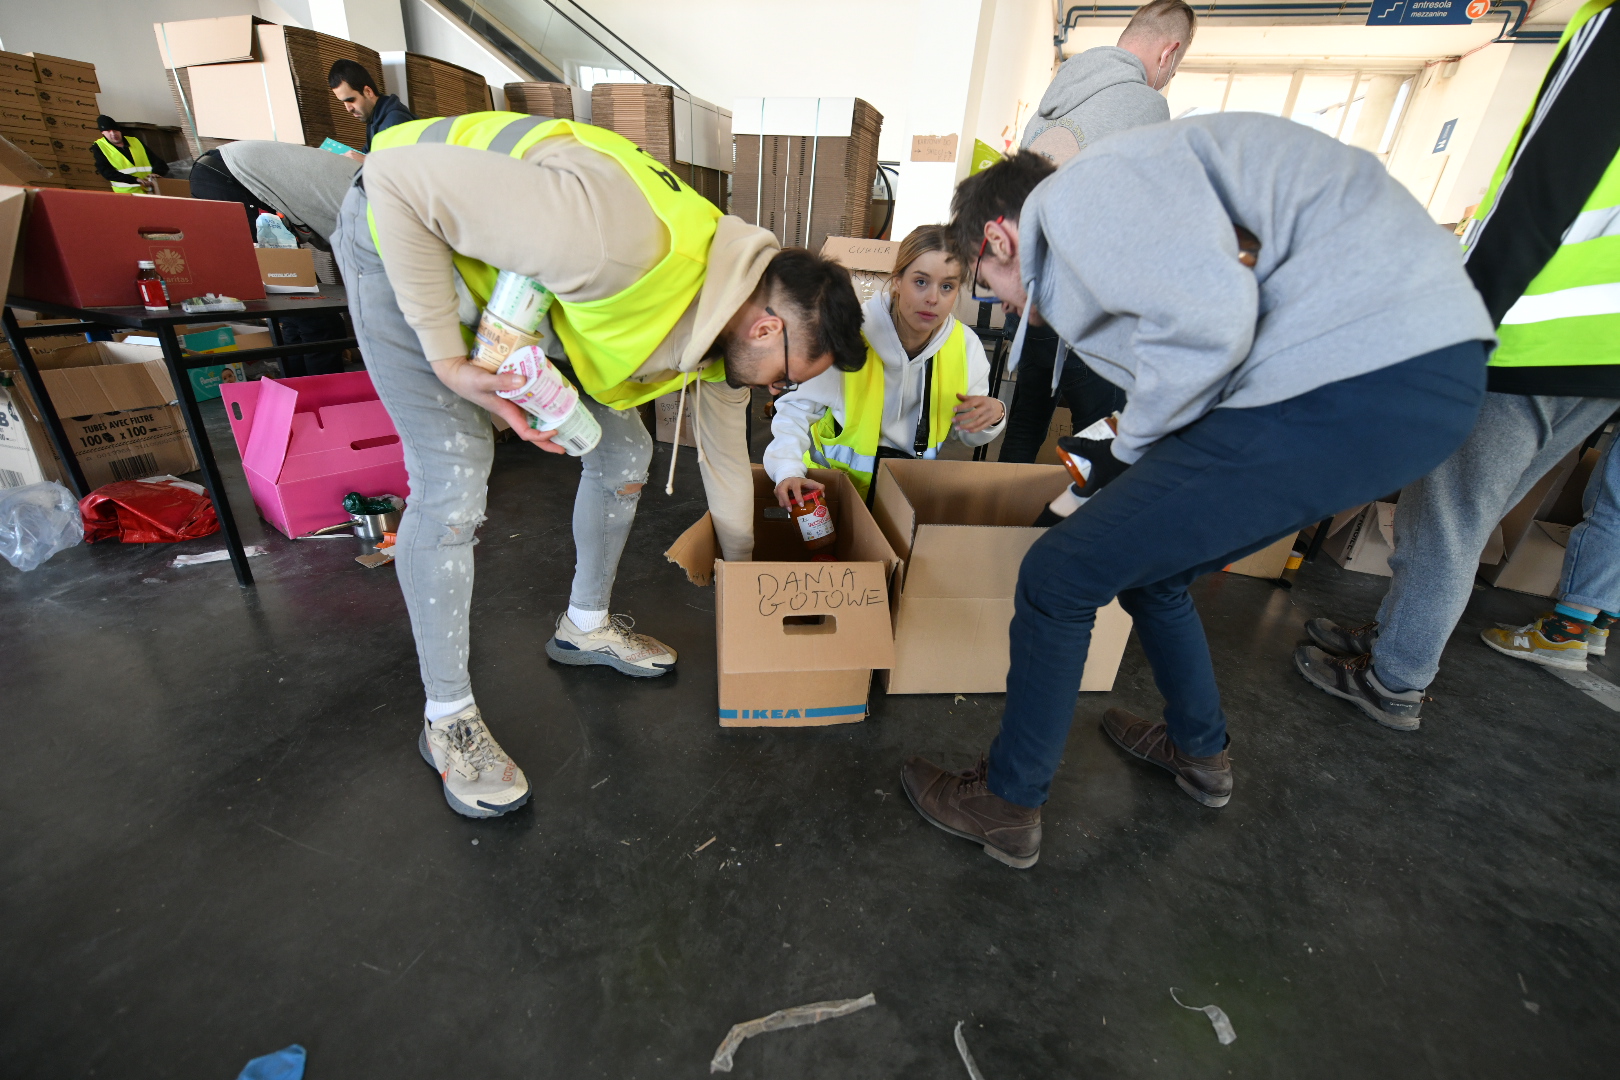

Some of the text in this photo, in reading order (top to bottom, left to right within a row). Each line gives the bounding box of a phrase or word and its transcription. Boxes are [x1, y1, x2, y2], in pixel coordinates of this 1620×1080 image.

[1412, 0, 1452, 9] antresola
[1410, 10, 1448, 18] mezzanine
[848, 245, 891, 254] CUKIER
[82, 414, 155, 434] TUBES AVEC FILTRE
[80, 434, 102, 447] 100
[126, 425, 147, 438] 100
[758, 588, 884, 617] GOTOWE
[742, 708, 801, 719] IKEA
[502, 757, 516, 782] GORE
